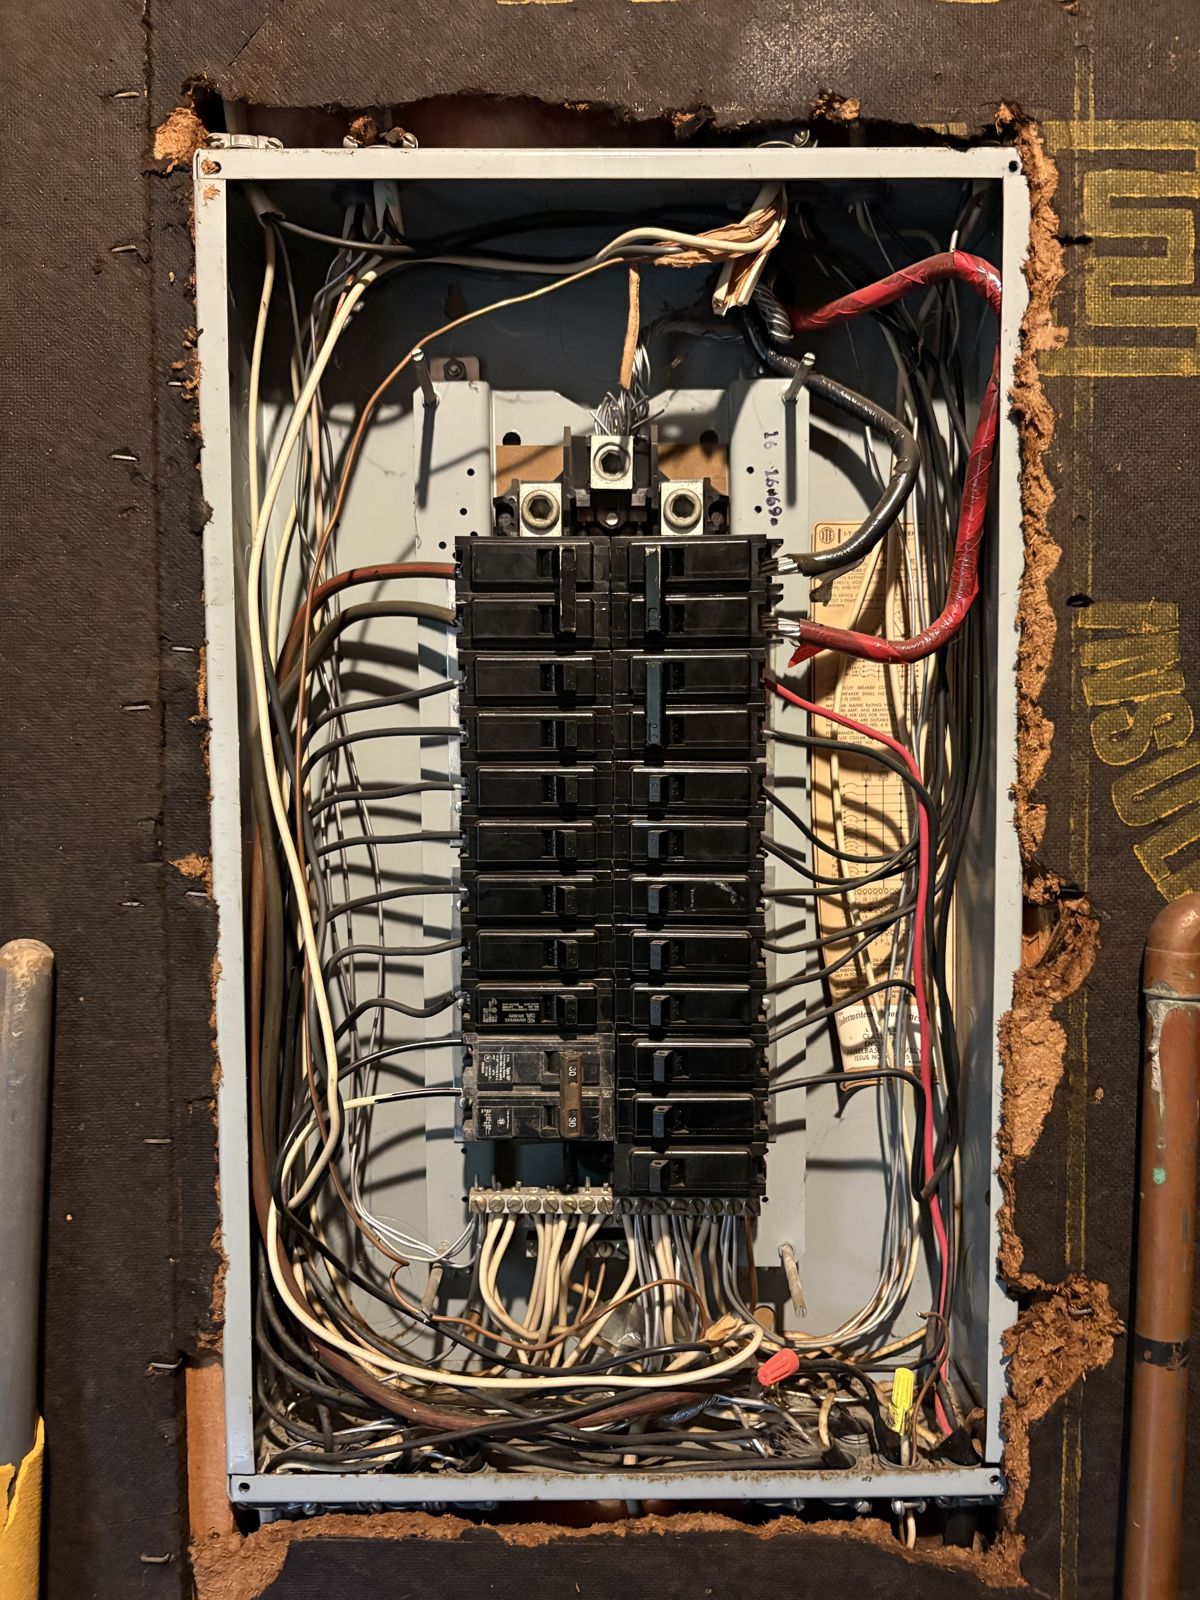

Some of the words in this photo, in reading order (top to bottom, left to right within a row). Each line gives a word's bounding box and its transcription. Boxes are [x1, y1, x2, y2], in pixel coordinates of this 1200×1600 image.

[1077, 601, 1200, 904] INSUL
[568, 1066, 577, 1077] 30
[568, 1117, 577, 1128] 30
